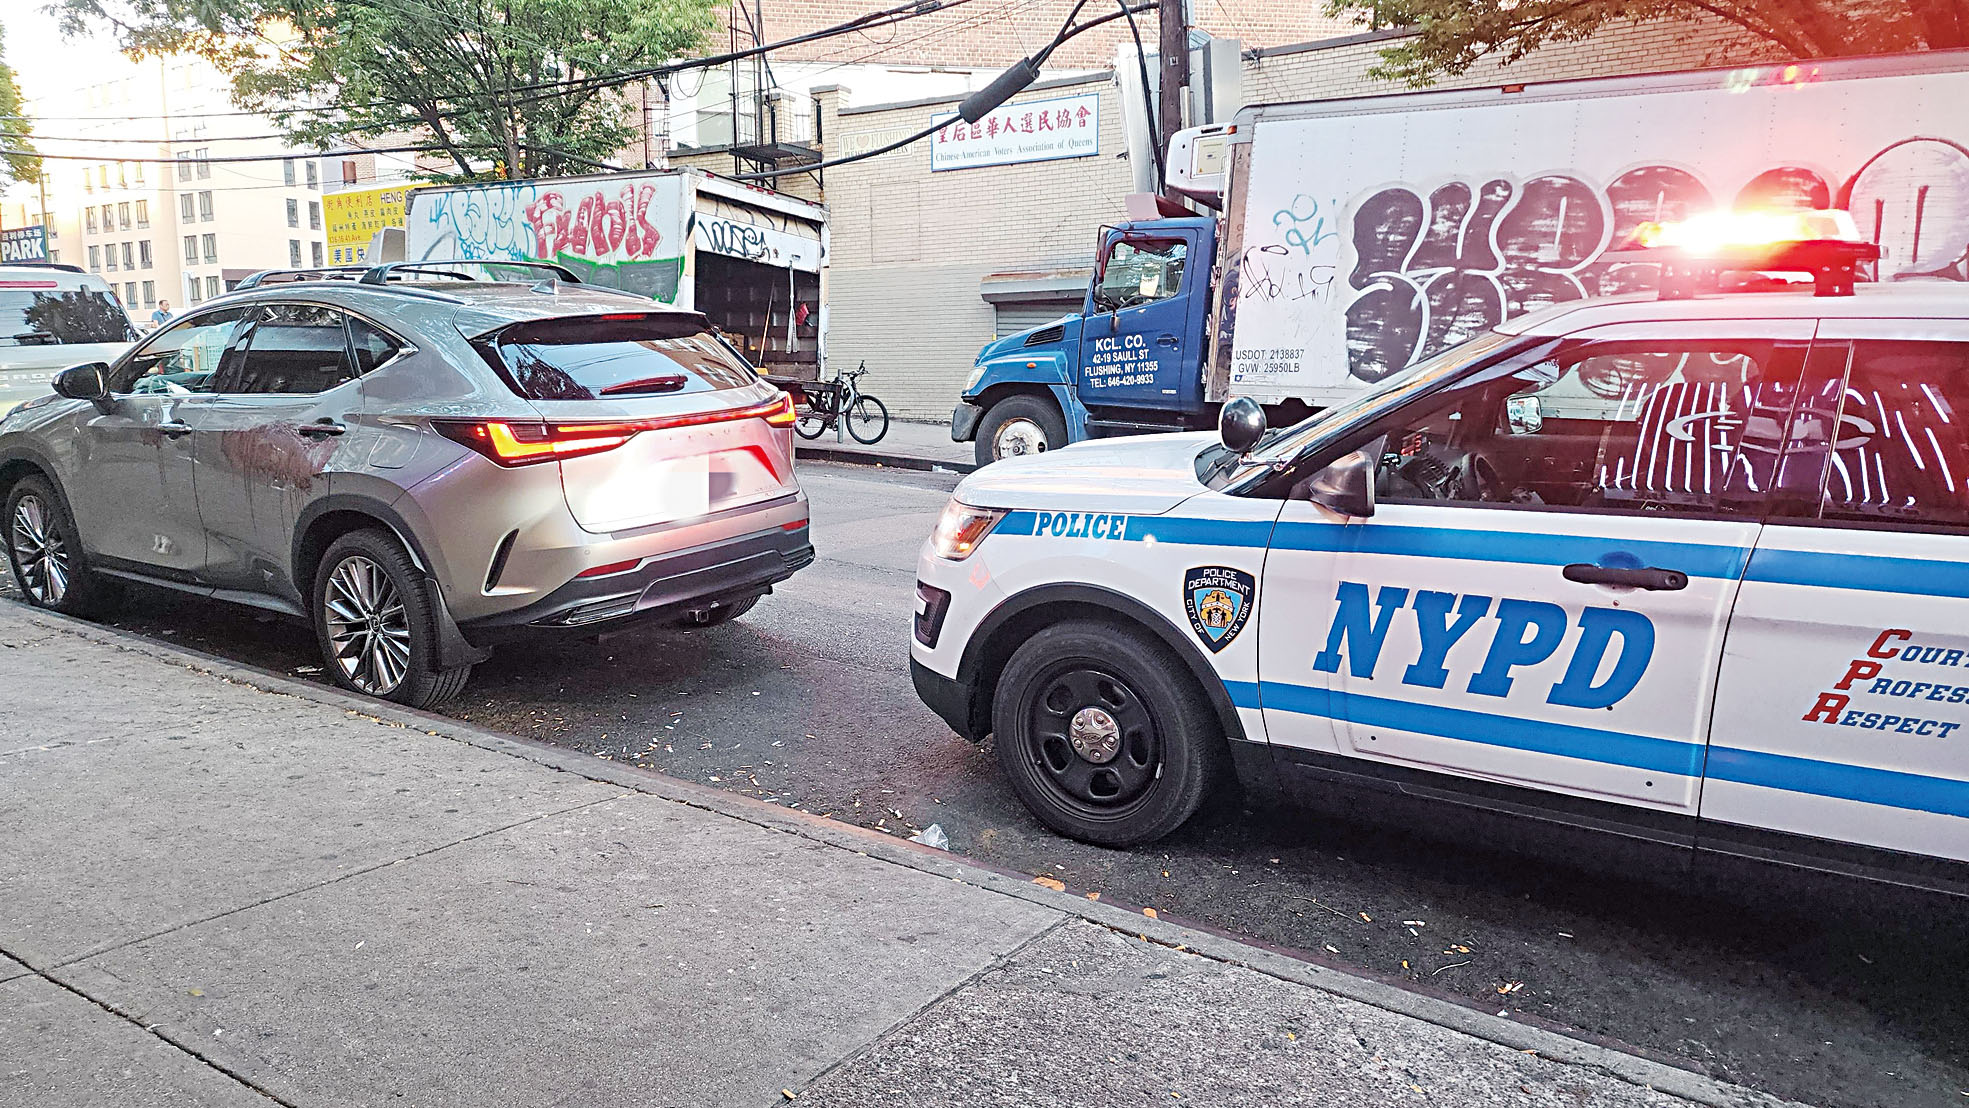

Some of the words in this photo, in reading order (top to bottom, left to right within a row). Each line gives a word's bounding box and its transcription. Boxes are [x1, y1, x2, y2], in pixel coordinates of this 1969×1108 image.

[935, 150, 991, 162] Chinese-American
[995, 147, 1013, 156] Voters
[1017, 142, 1054, 154] Association
[1058, 140, 1065, 148] of
[1068, 138, 1093, 148] Queens
[380, 191, 402, 204] HENG
[1, 238, 45, 262] PARK
[1096, 338, 1122, 352] KCL.
[1124, 334, 1146, 348] CO.
[1092, 353, 1111, 364] 42-19
[1112, 350, 1138, 362] SAULL
[1138, 348, 1150, 360] ST
[1270, 348, 1304, 360] 2138837
[1084, 364, 1124, 377] FLUSHING,
[1124, 362, 1136, 374] NY
[1137, 360, 1158, 372] 11355
[1264, 362, 1300, 373] 25950LB
[1090, 378, 1106, 388] TEL:
[1108, 374, 1154, 388] 646-420-9933
[1035, 512, 1126, 540] POLICE
[1203, 568, 1238, 580] POLICE
[1188, 577, 1250, 596] DEPARTMENT
[1186, 599, 1198, 620] CITY
[1194, 622, 1205, 634] OF
[1224, 623, 1240, 642] NEW
[1238, 601, 1250, 622] YORK
[1312, 581, 1656, 710] NYPD
[1867, 628, 1969, 668] COUR
[1833, 660, 1969, 704] PROFES
[1802, 692, 1960, 738] RESPECT
